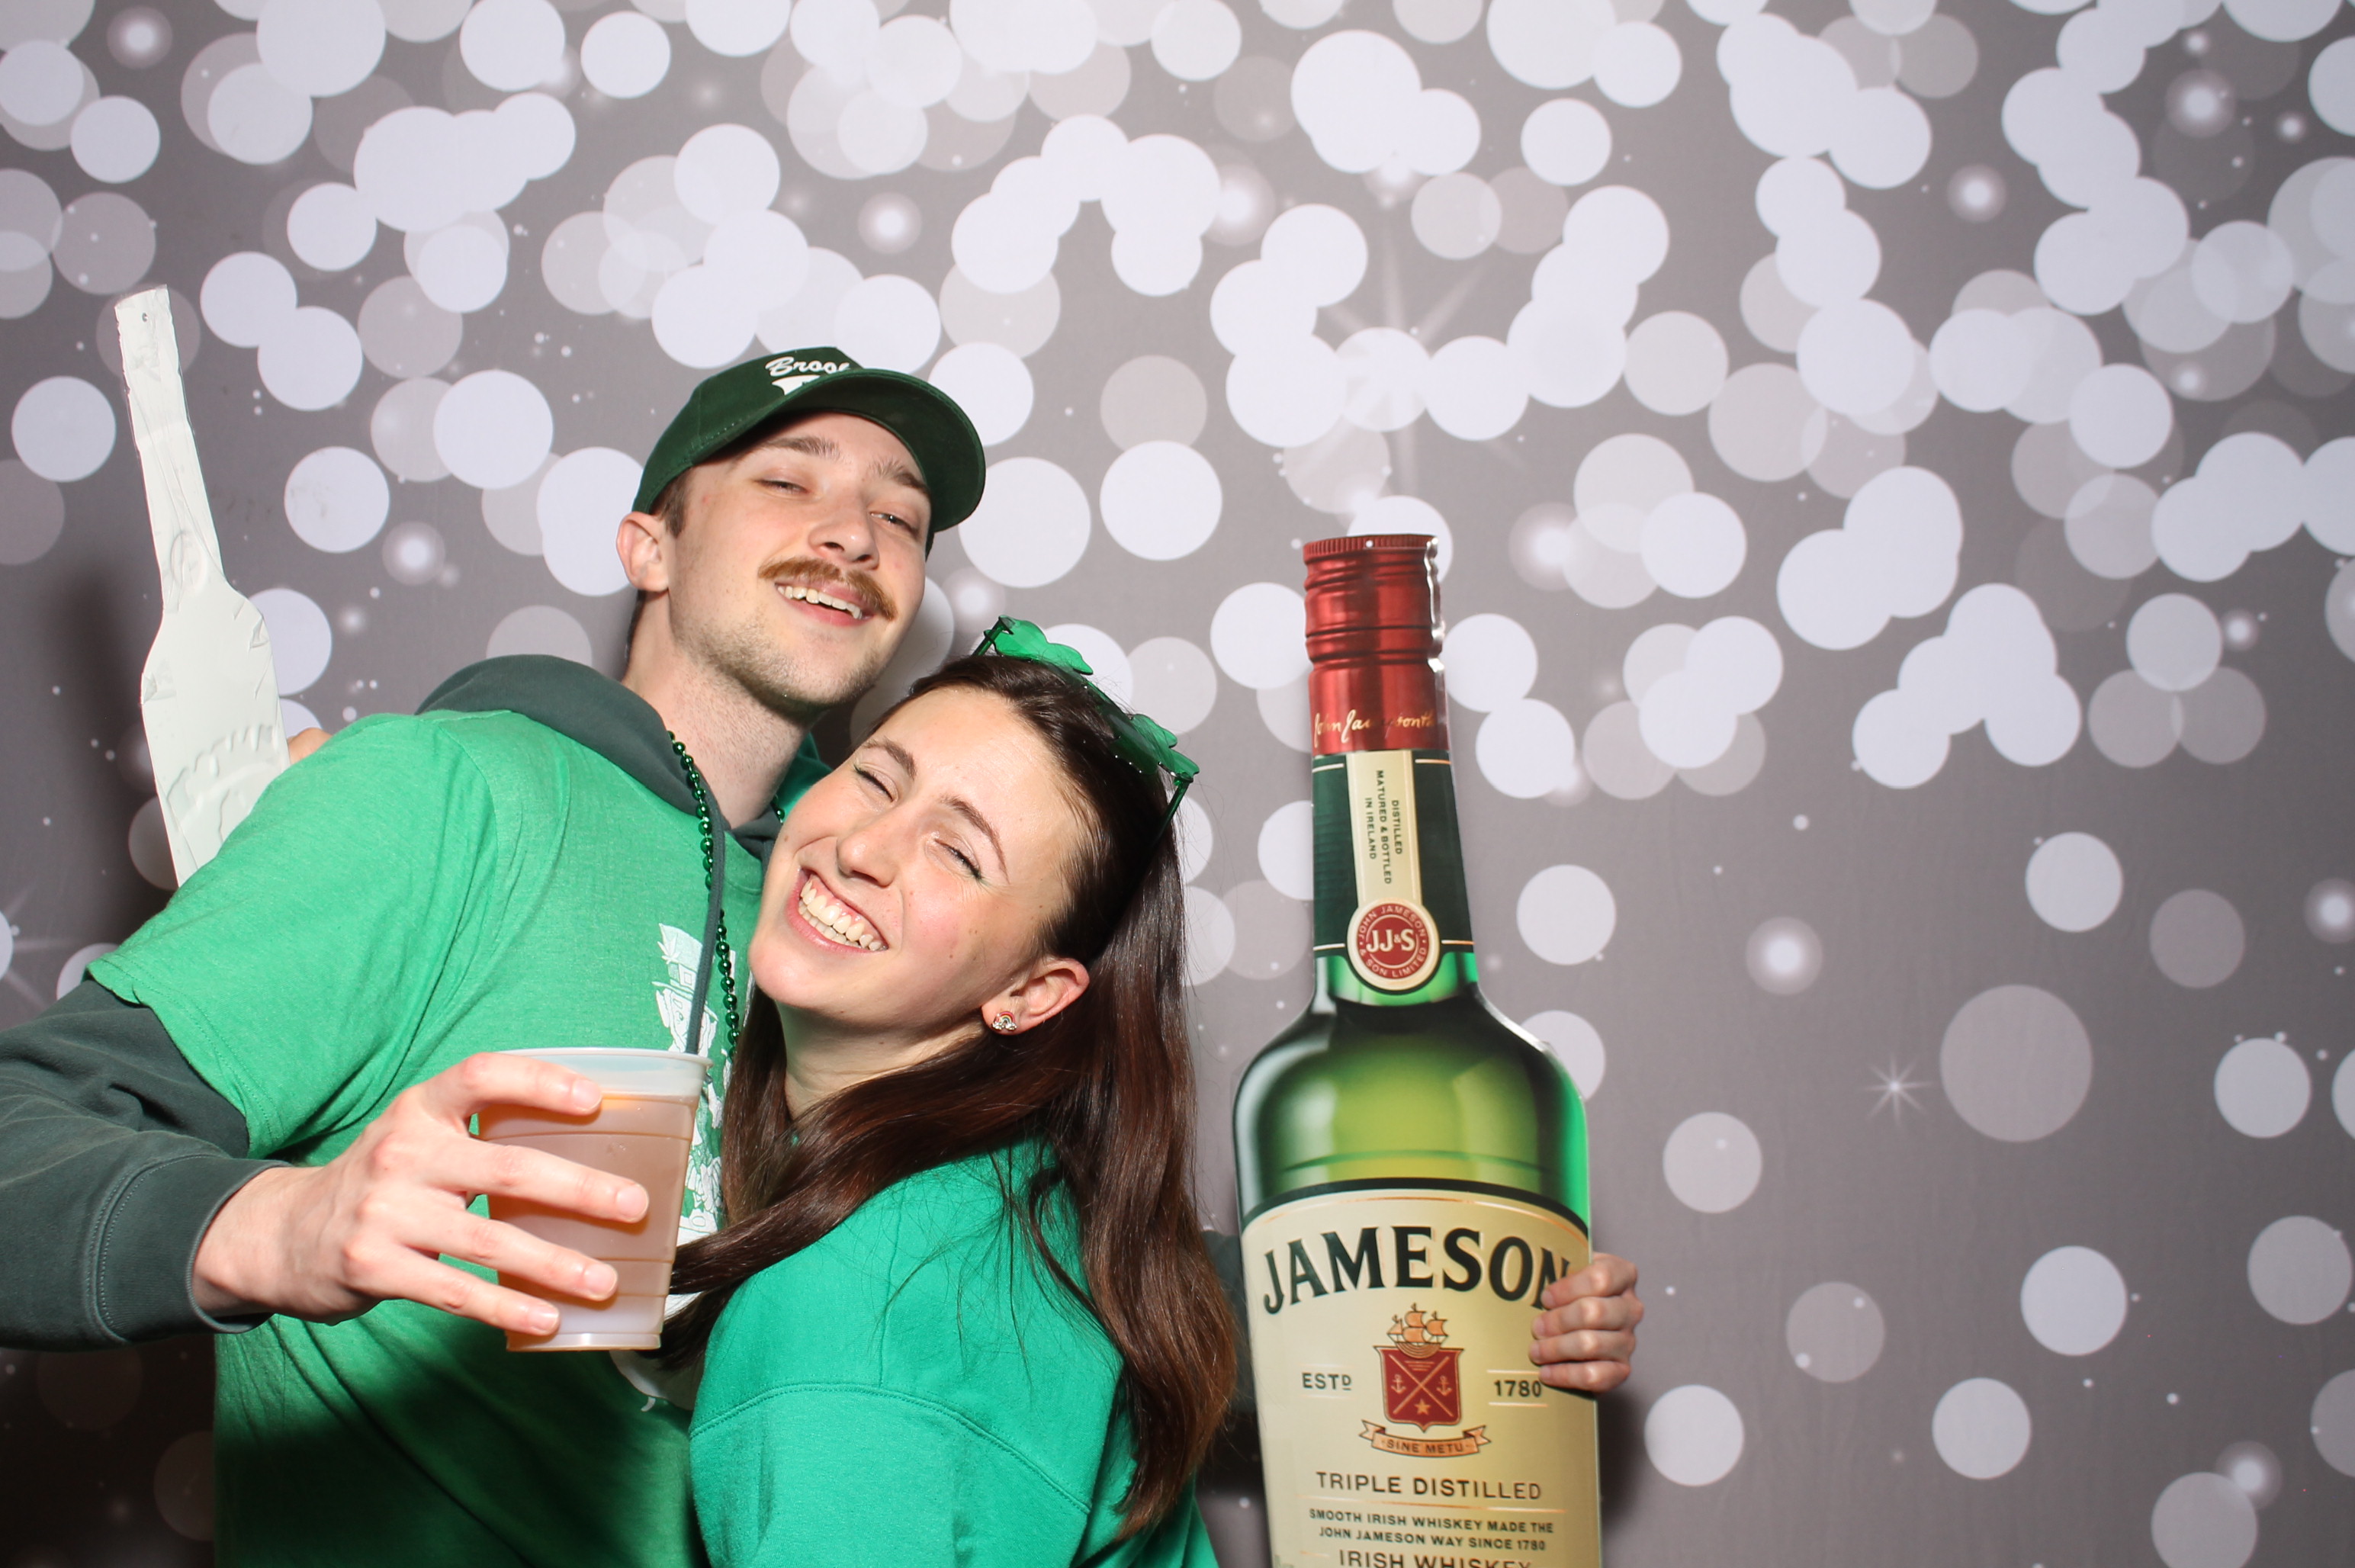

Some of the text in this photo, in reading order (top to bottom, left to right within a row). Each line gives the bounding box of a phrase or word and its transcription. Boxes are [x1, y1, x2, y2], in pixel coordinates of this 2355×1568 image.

[1376, 770, 1387, 823] MATURED
[1365, 797, 1377, 860] IN IRELAND
[1392, 799, 1403, 855] DISTILLED
[1380, 836, 1392, 885] BOTTLED
[1358, 905, 1427, 940] JOHN JAMESON
[1365, 928, 1416, 953] JJ&S
[1365, 959, 1388, 976] SON
[1391, 947, 1427, 978] LIMITED
[1263, 1226, 1571, 1315] JAMESON
[1493, 1380, 1543, 1398] 1780
[1386, 1438, 1465, 1454] SINE METU
[1316, 1471, 1542, 1500] TRIPLE DISTILLED
[1309, 1508, 1554, 1534] SMOOTH IRISH WHISKEY MADE THE
[1319, 1526, 1545, 1551] JOHN JAMESON WAY SINCE 1780
[1339, 1549, 1405, 1568] IRISH
